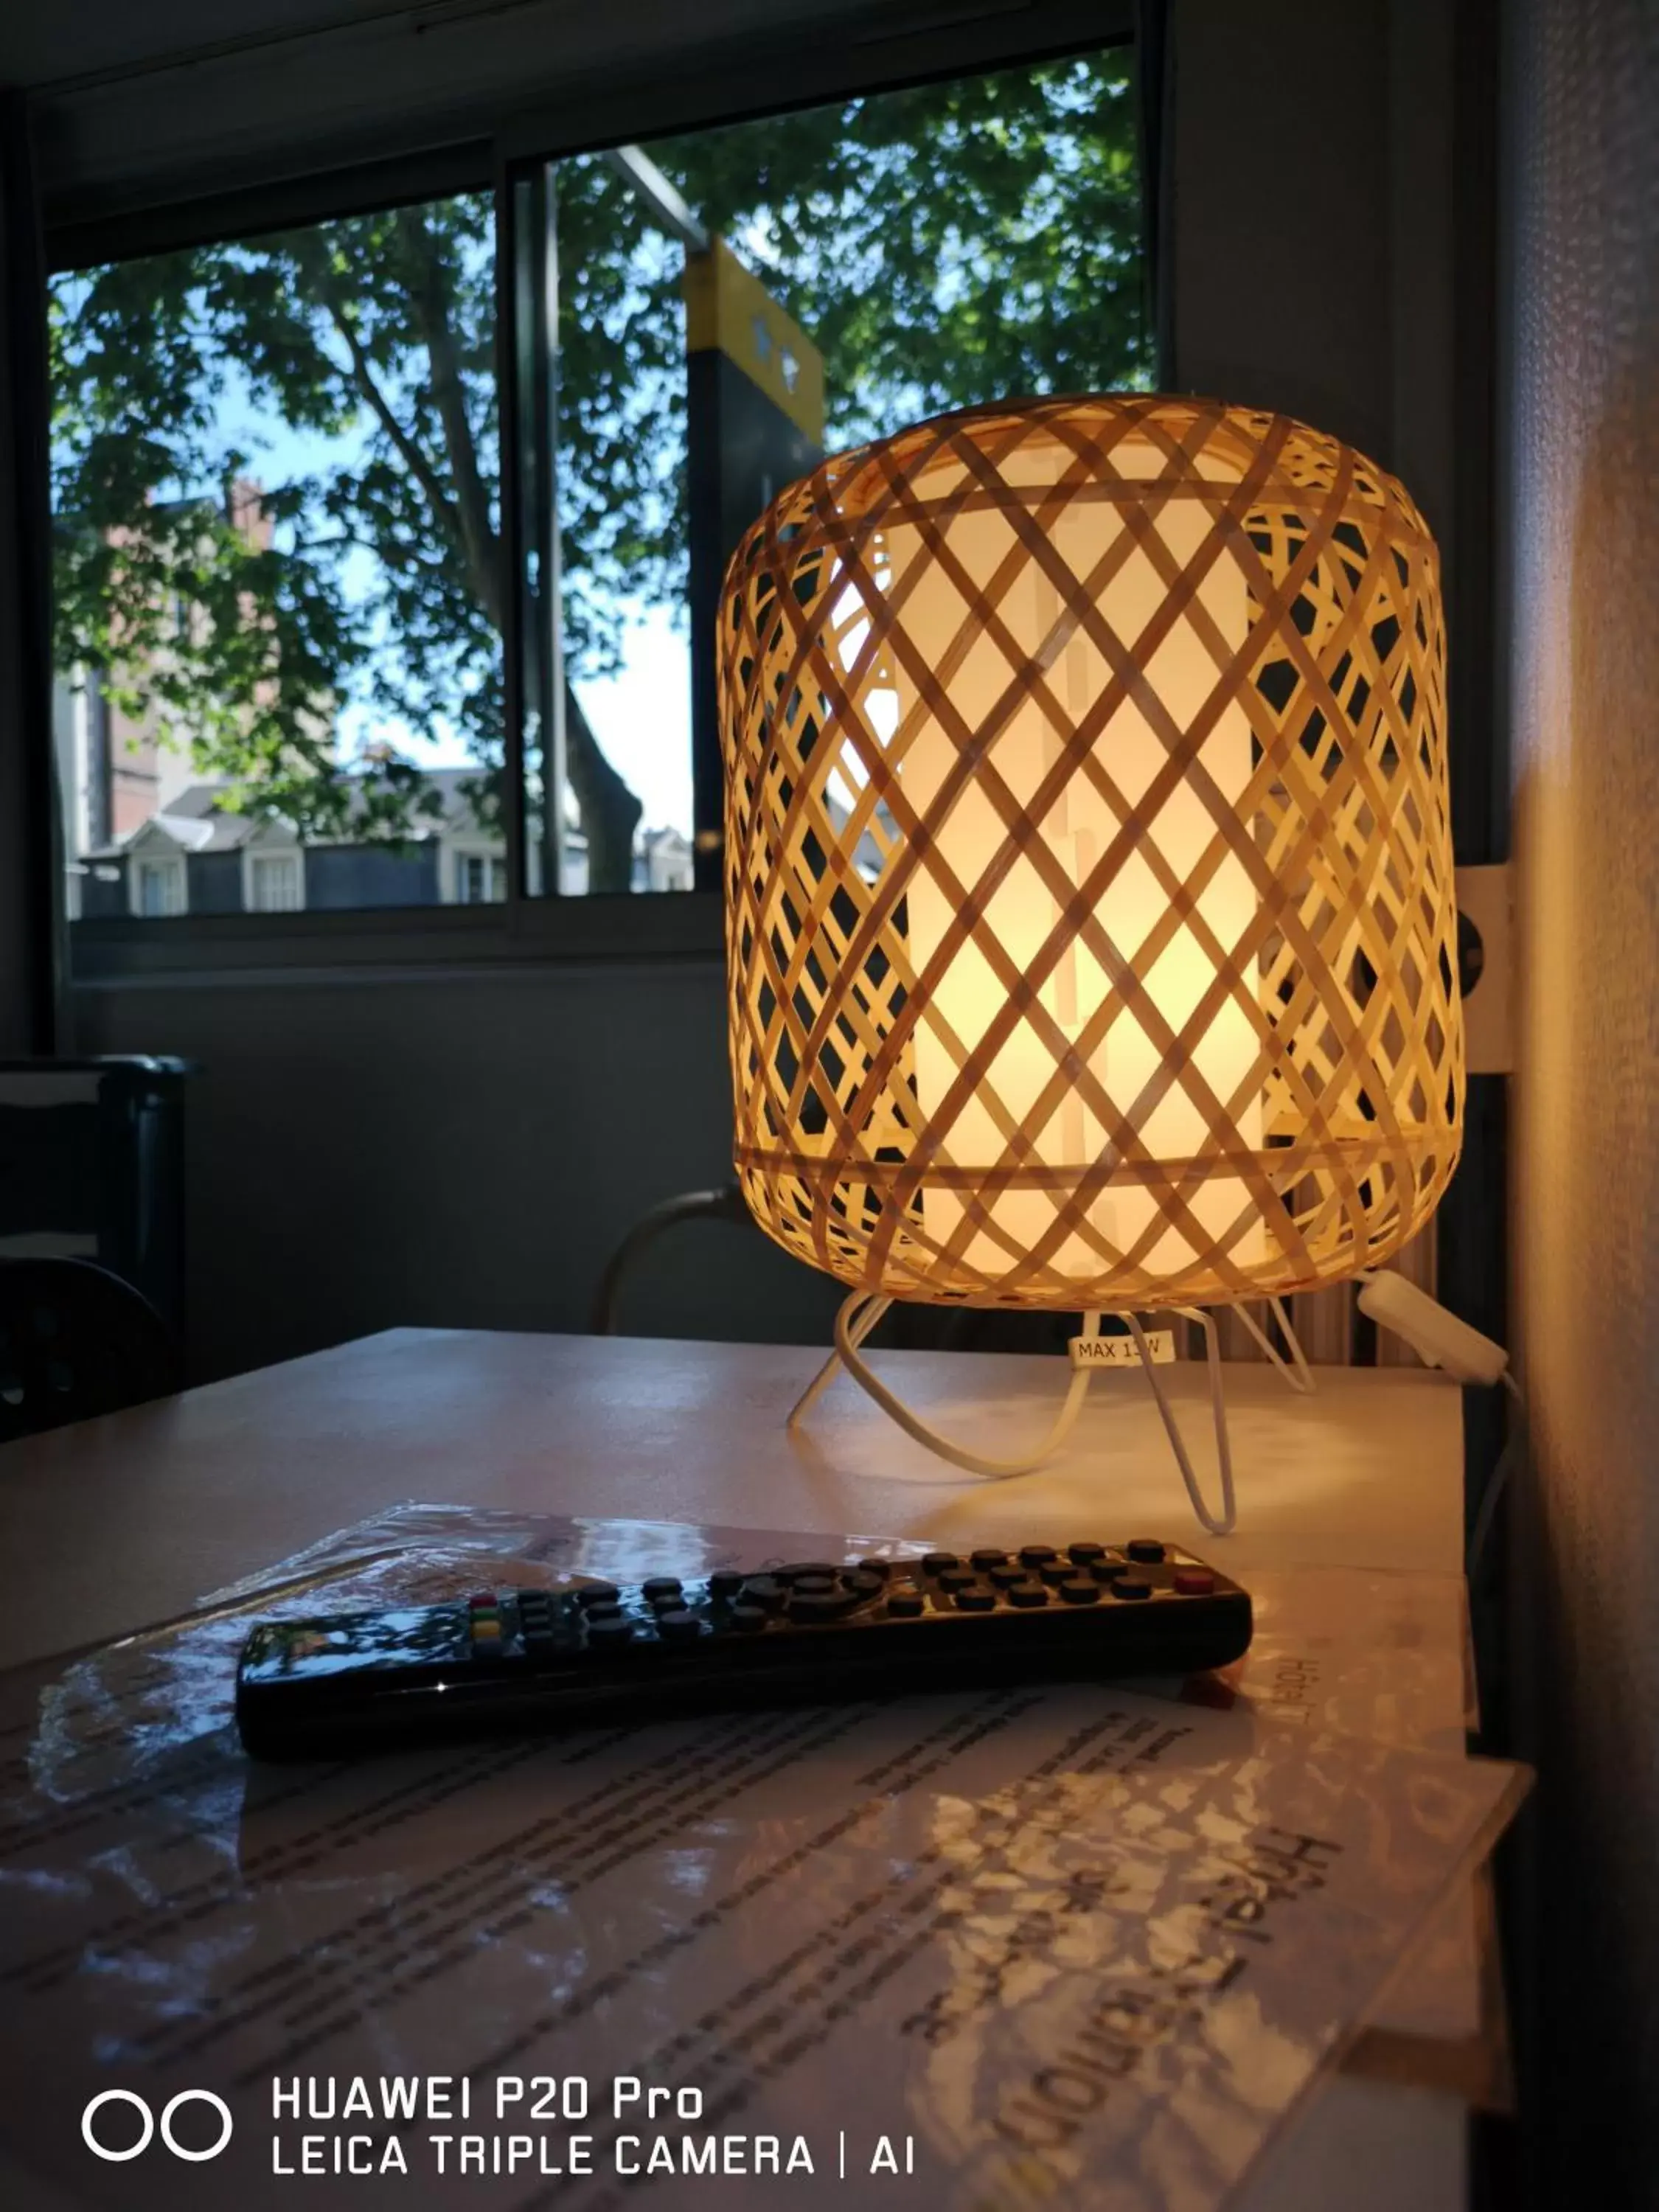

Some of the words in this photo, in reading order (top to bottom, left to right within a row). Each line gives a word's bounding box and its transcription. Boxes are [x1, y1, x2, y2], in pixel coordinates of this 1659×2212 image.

[1078, 1342, 1116, 1358] MAX
[1123, 1338, 1161, 1358] 1W
[1270, 1656, 1321, 1708] Hôtel
[1200, 1827, 1343, 1944] Hôtel
